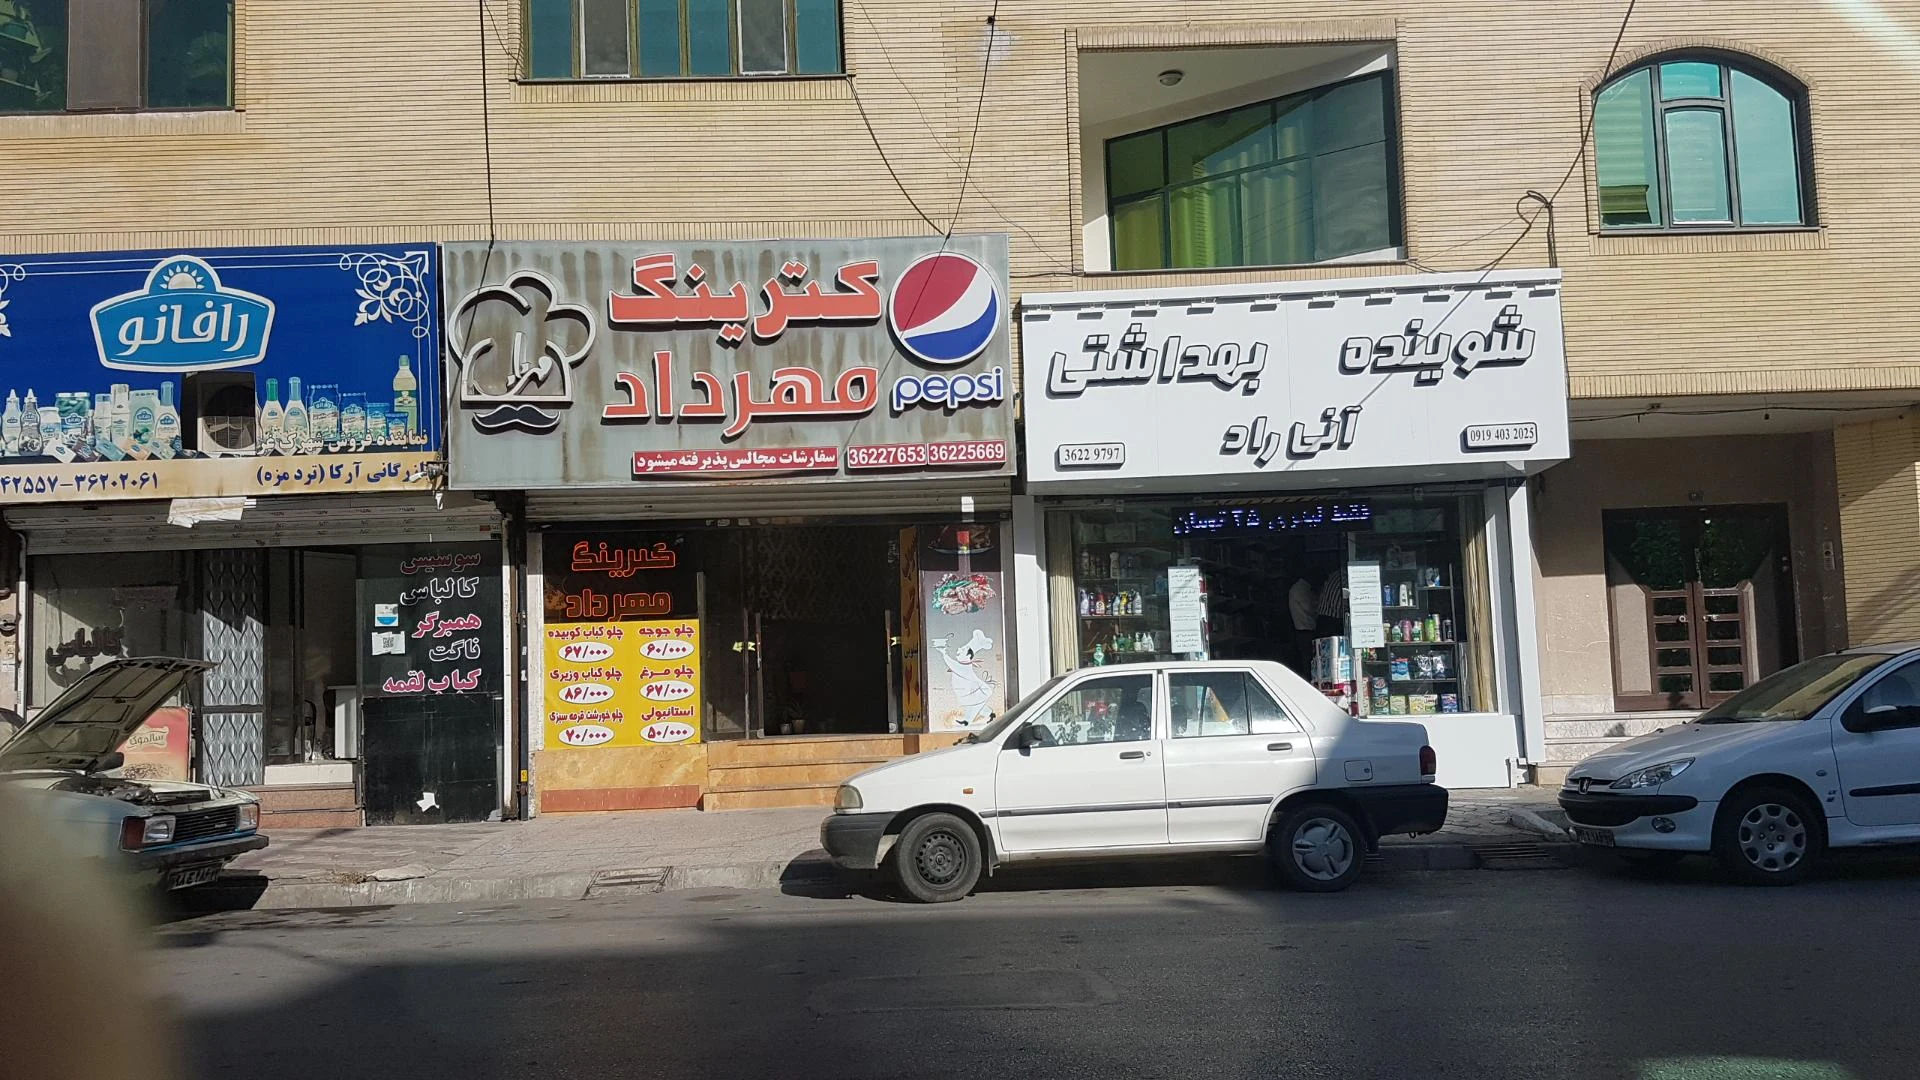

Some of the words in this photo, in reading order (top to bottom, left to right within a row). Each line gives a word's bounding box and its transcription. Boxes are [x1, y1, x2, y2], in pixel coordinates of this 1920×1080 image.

[608, 252, 882, 346] کترینگ
[115, 300, 249, 356] رافانو
[1340, 304, 1536, 386] شوینده
[1046, 323, 1268, 397] بهداشتی
[602, 351, 880, 441] مهرداد
[892, 366, 1004, 411] pepsi
[328, 430, 373, 452] فروش
[377, 429, 429, 450] نماینده
[1286, 404, 1363, 460] آنی
[1471, 430, 1491, 441] 0919
[1495, 428, 1510, 440] 403
[1513, 427, 1534, 439] 2025
[256, 434, 275, 455] غر
[278, 432, 324, 454] شهرک
[930, 443, 1004, 461] 36225669
[1219, 416, 1281, 469] راد
[636, 454, 678, 472] میشود
[679, 451, 728, 470] پذیرفته
[729, 451, 776, 468] مجالس
[778, 450, 836, 468] سفارشات
[850, 446, 926, 464] 36227653
[1064, 448, 1090, 461] 3622
[1093, 448, 1120, 460] 9797
[257, 465, 290, 487] مزه)
[330, 461, 362, 484] آرکا
[400, 553, 481, 575] سوسیس
[400, 577, 480, 605] کالباس
[566, 588, 671, 623] مهرداد
[412, 611, 482, 638] همبرگر
[548, 627, 581, 640] کوبیده
[583, 626, 604, 639] کباب
[606, 625, 624, 640] چلو
[639, 626, 671, 638] جوجه
[674, 624, 695, 638] چلو
[429, 637, 481, 662] ناگت
[383, 670, 426, 693] لقمه
[428, 668, 482, 695] کباب
[550, 669, 579, 682] وزیری
[581, 667, 603, 680] کباب
[605, 667, 623, 681] چلو
[674, 665, 695, 679] چلو
[549, 711, 568, 724] سبزی
[569, 710, 585, 723] قرمه
[586, 709, 611, 723] خورشت
[611, 709, 624, 723] چلو
[641, 706, 695, 721] استانبولی
